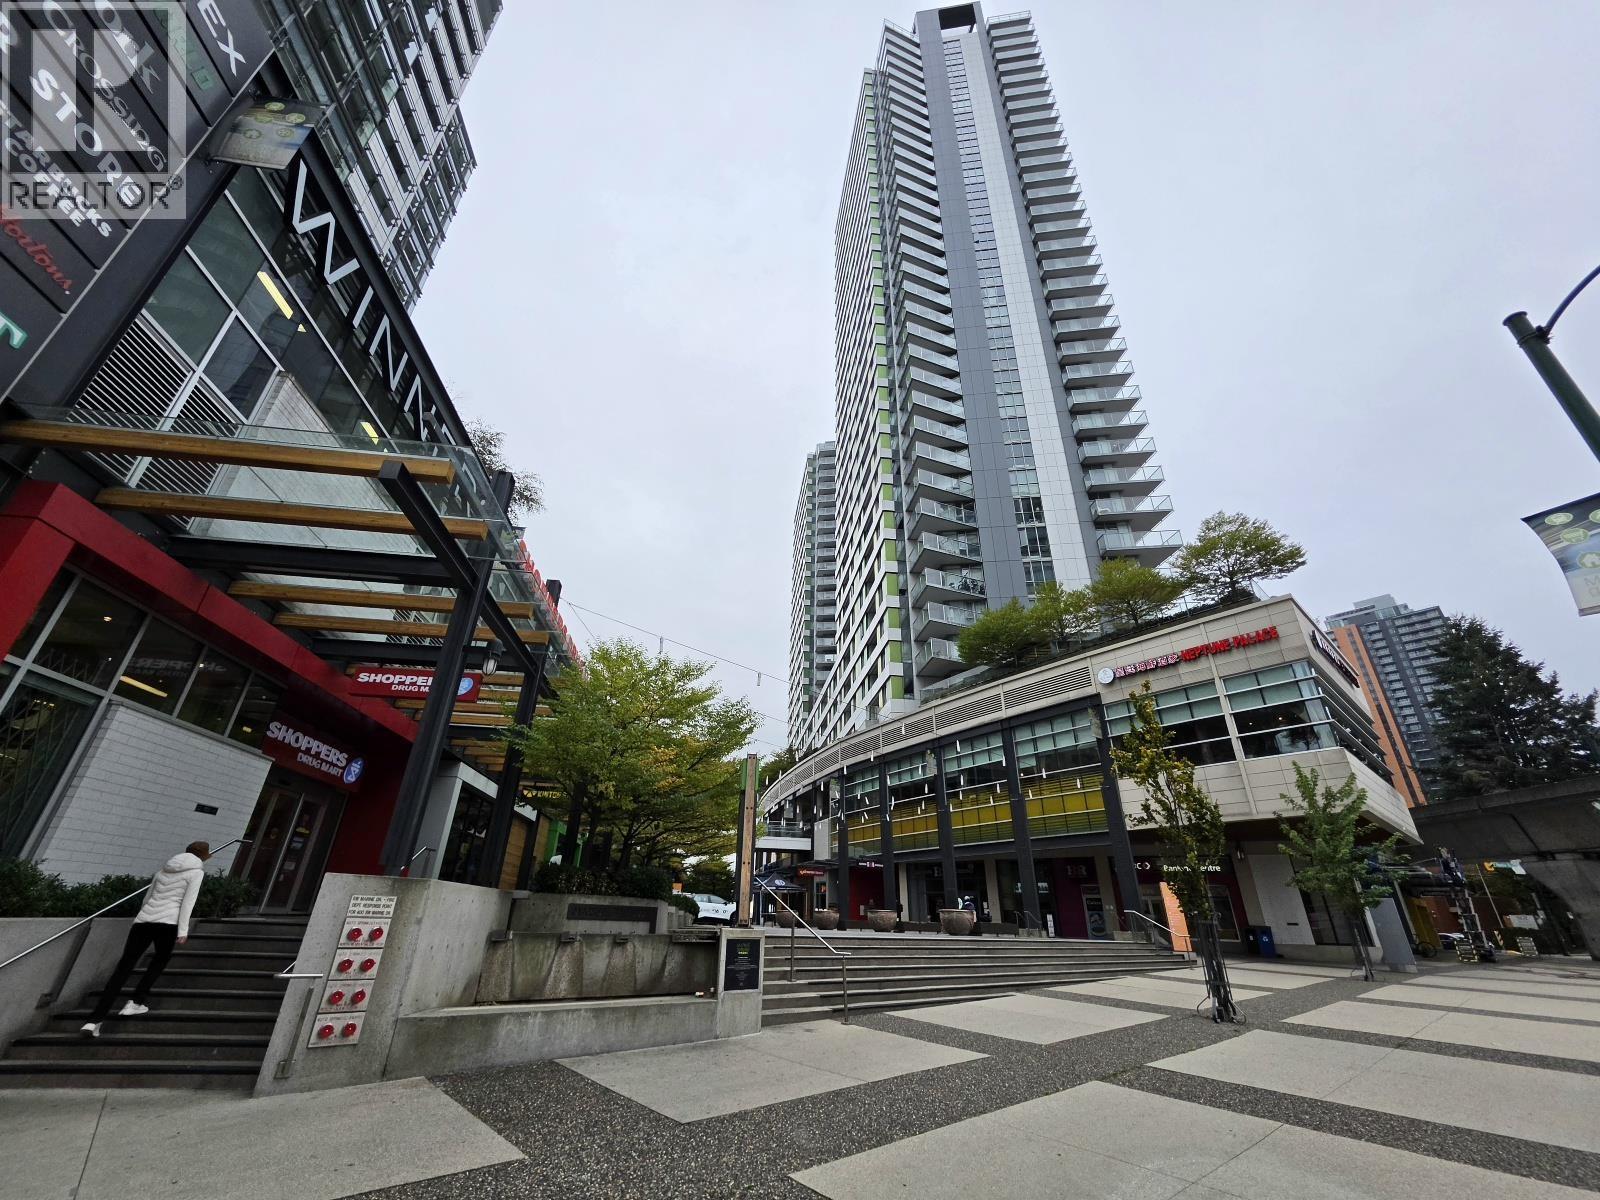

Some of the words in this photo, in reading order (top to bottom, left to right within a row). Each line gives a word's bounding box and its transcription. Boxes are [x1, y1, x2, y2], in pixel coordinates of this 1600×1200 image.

[29, 69, 142, 208] STORE
[5, 138, 85, 227] COFFEE
[356, 672, 433, 686] SHOPPE
[391, 684, 418, 692] DRUG
[266, 721, 348, 767] SHOPPERS
[297, 751, 321, 769] DRUG
[320, 761, 344, 777] MART
